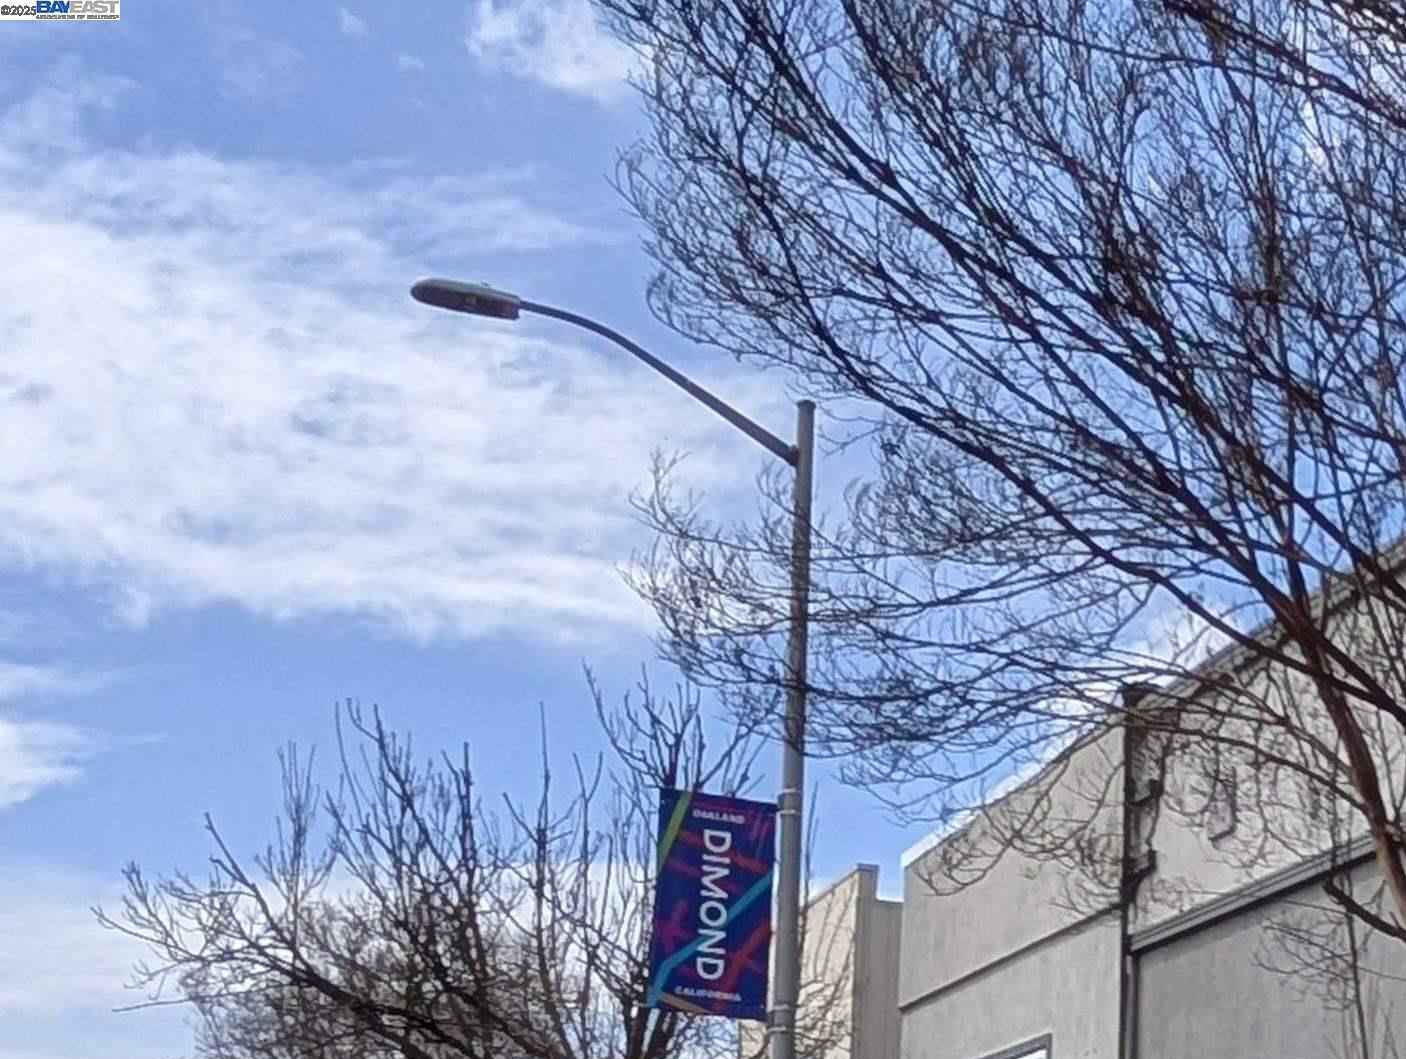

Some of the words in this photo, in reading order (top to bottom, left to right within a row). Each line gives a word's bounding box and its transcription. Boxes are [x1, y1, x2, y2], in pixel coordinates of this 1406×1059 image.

[693, 809, 745, 824] OAKLAND
[696, 829, 732, 981] DIMOND
[674, 986, 742, 1001] CALIFORNIA
